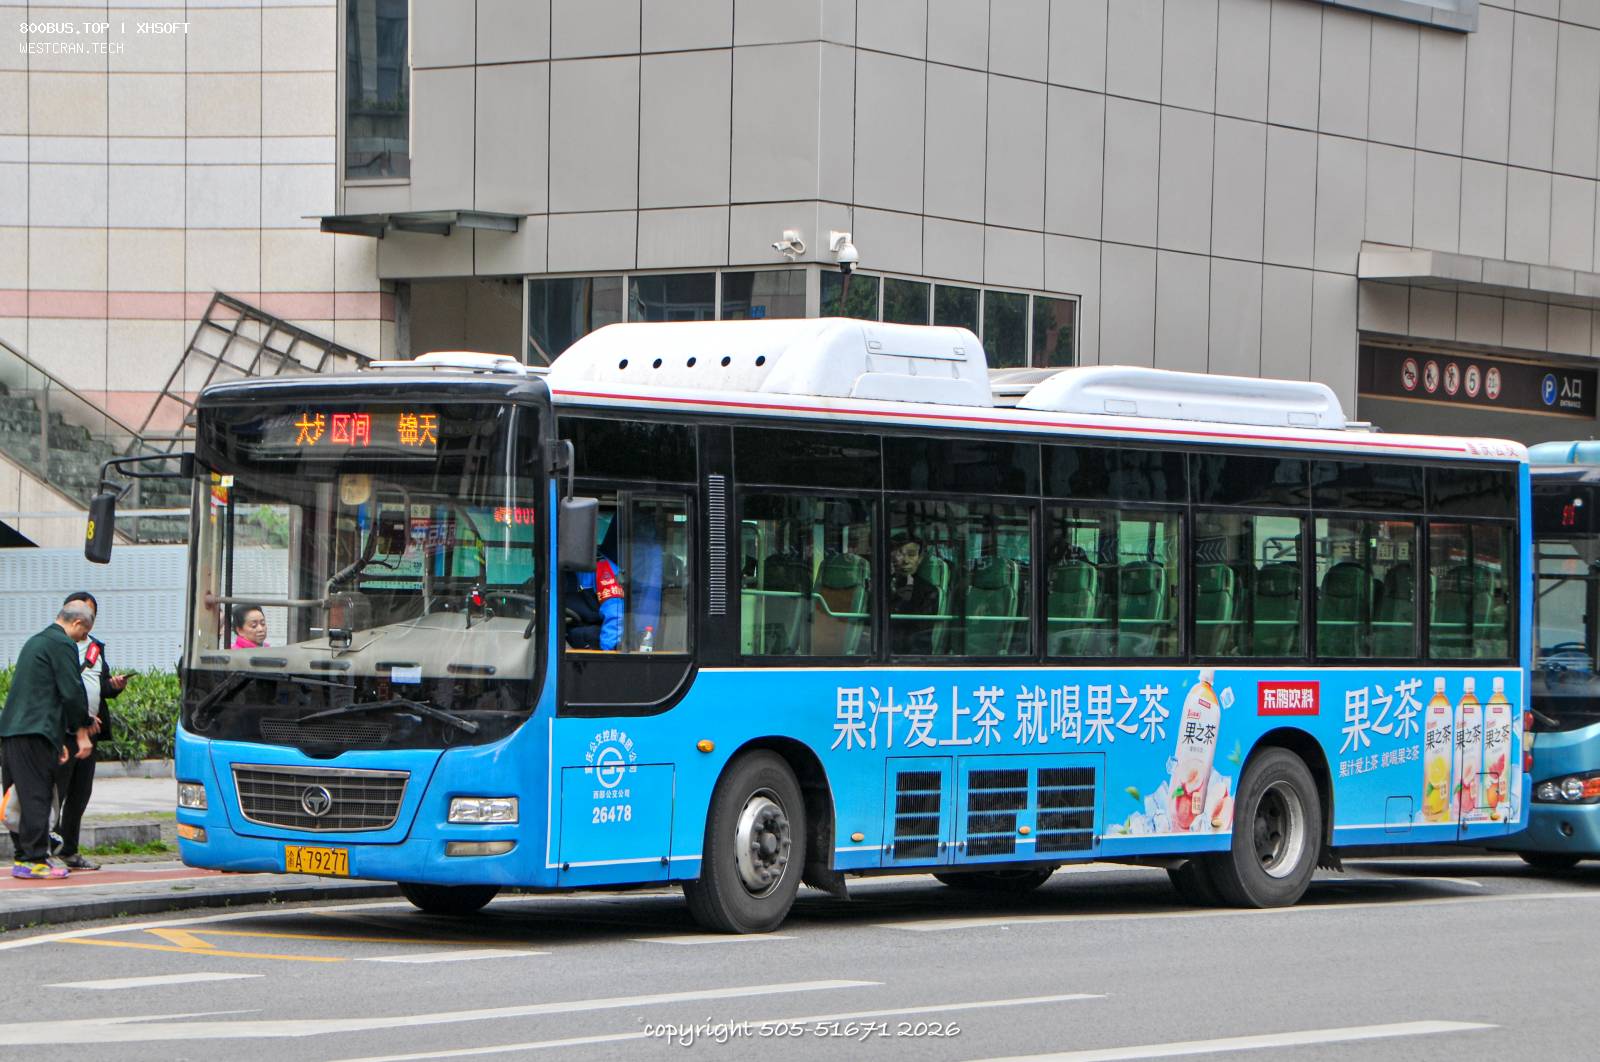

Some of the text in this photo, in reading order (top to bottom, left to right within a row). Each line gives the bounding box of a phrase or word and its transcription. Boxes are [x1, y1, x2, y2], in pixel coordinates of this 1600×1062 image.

[1545, 380, 1553, 399] P
[1560, 376, 1582, 398] 入口
[331, 413, 370, 447] 区间
[398, 412, 438, 446] 锦天
[1263, 688, 1314, 709] 东鹏饮料
[831, 684, 1170, 750] 果汁爱上茶 就喝果之茶
[1339, 678, 1423, 754] 果之茶
[1182, 721, 1216, 745] 果之茶
[1425, 725, 1451, 752] 果之茶
[1456, 725, 1481, 752] 果之茶
[1485, 725, 1510, 750] 果之茶
[1339, 745, 1420, 777] 果汁爱上茶 就喝果之茶
[592, 804, 632, 824] 26478
